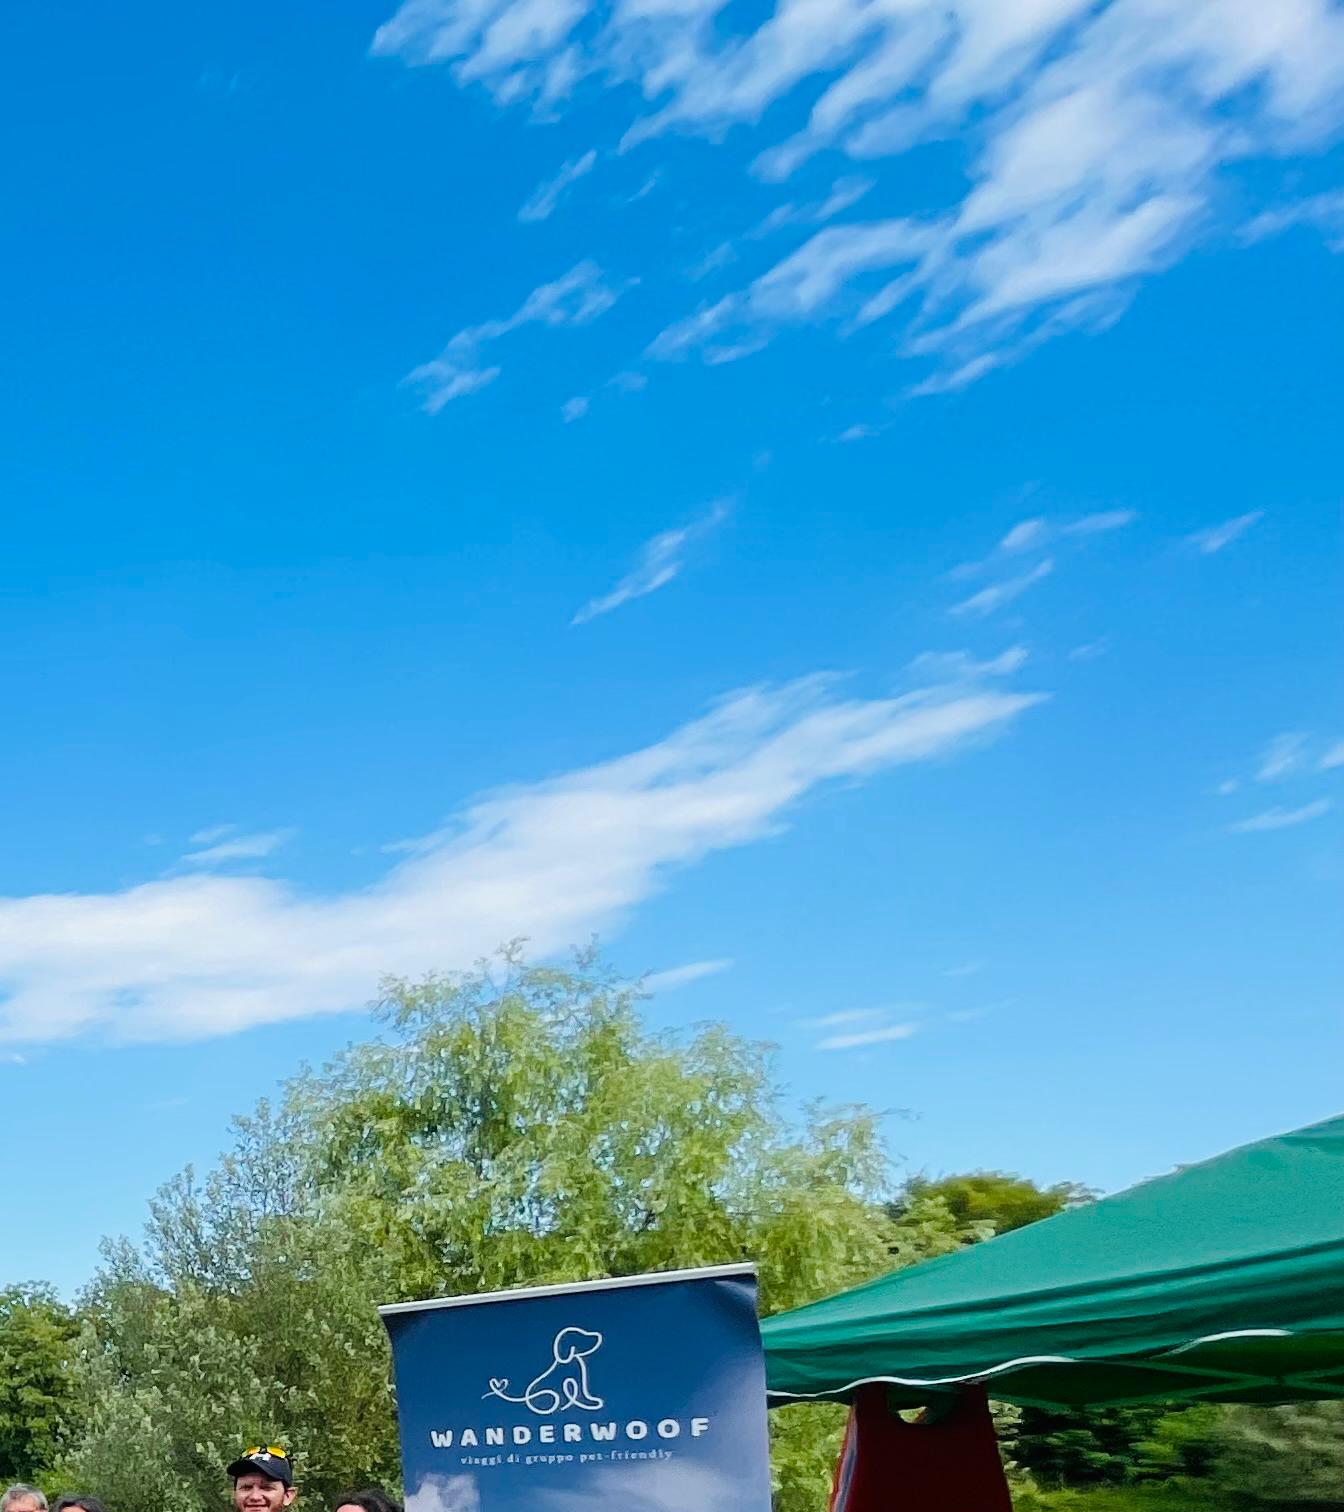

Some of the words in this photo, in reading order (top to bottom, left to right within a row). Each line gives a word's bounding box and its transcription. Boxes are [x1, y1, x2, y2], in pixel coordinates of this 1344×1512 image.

[430, 1417, 710, 1448] WANDERWOOF
[460, 1454, 502, 1466] viaggi
[507, 1452, 520, 1463] di
[525, 1453, 574, 1466] gruppo
[579, 1449, 673, 1464] pet-friendly
